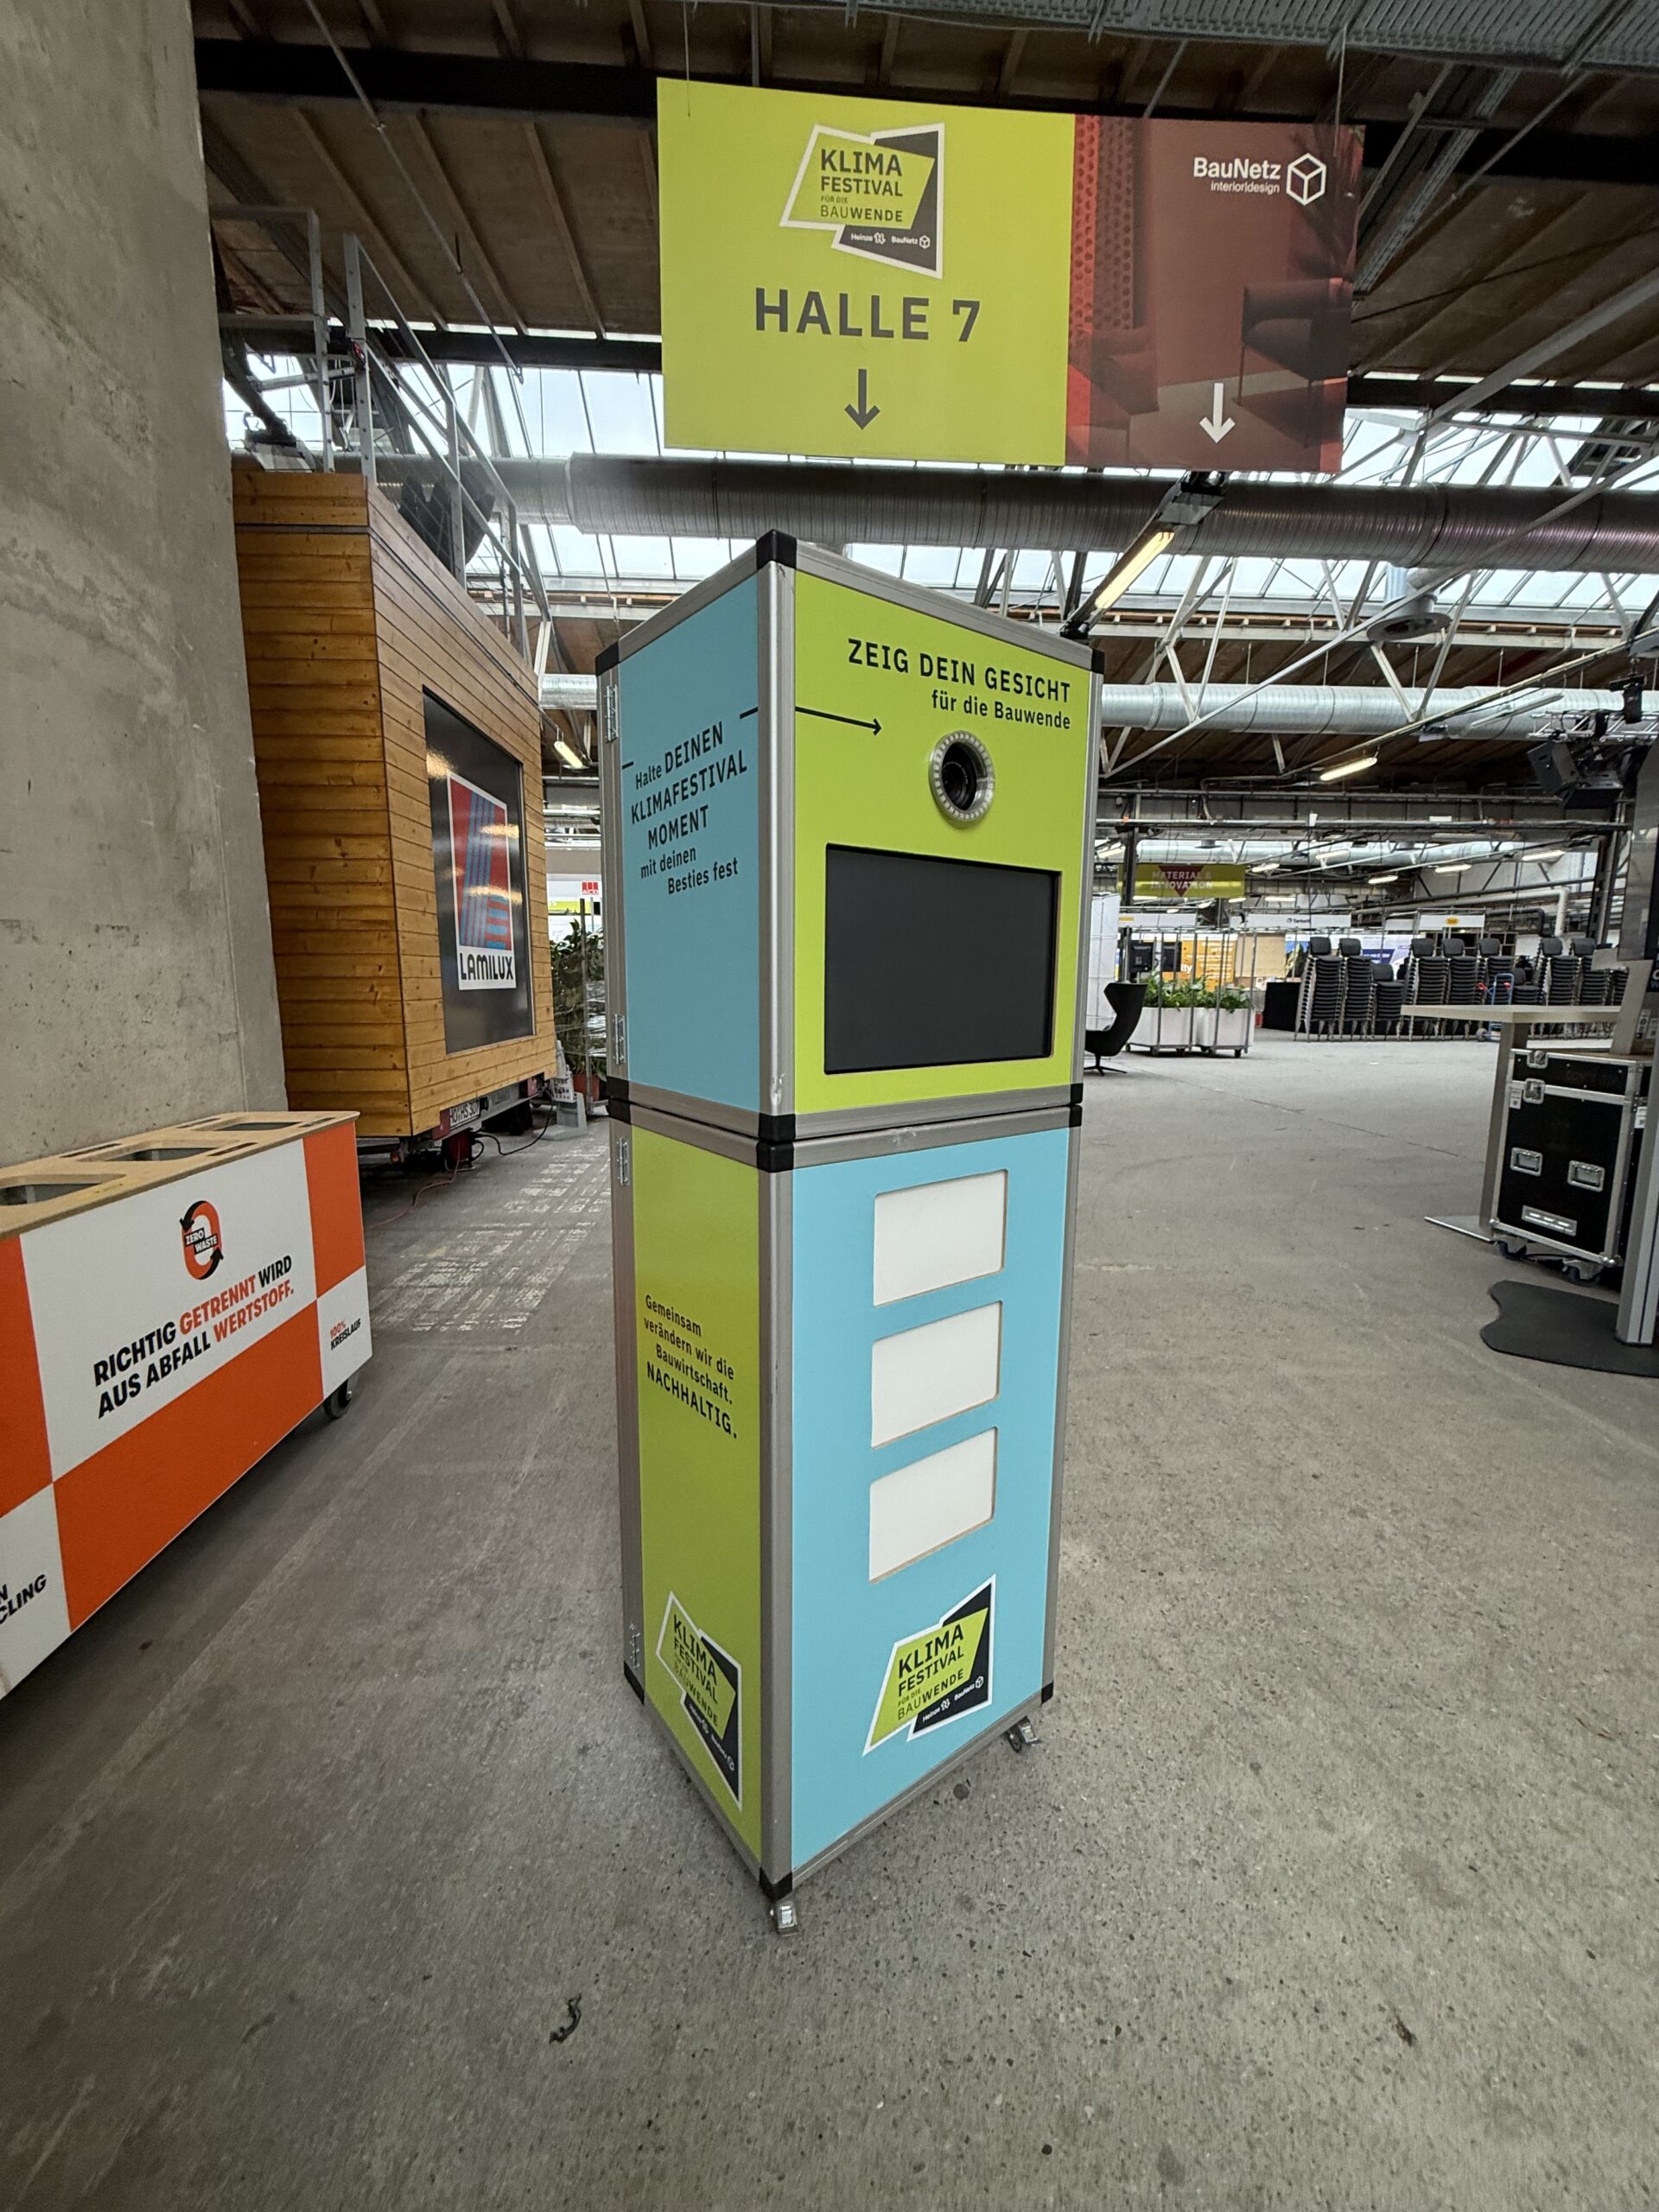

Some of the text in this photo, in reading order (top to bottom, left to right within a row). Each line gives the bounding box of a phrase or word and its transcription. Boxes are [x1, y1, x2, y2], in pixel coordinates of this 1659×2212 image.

[821, 149, 902, 176] KLIMA
[1193, 156, 1281, 180] BauNetz
[821, 176, 903, 197] FESTIVAL
[821, 205, 903, 222] BAUWENDE
[851, 233, 918, 245] Heinze BauNetz
[755, 287, 981, 342] HALLE 7
[848, 638, 1071, 702] ZEIG DEIN GESICHT
[931, 690, 1071, 729] für die Bauwende
[636, 721, 723, 790] Halte DEINEN
[632, 749, 747, 824] KLIMAFESTIVAL
[648, 804, 709, 850] MOMENT
[640, 847, 696, 879] mit deinen
[668, 857, 738, 895] Besties fest
[460, 953, 514, 980] LAMILUX
[185, 1230, 204, 1244] ZERO
[195, 1235, 218, 1253] WASTE
[93, 1255, 292, 1387] RICHTIG GETRENNT WIRD
[330, 1318, 361, 1351] KREISLAUF
[645, 1294, 702, 1337] Gemeinsam
[99, 1279, 295, 1419] AUS ABFALL WERTSTOFF.
[644, 1318, 734, 1380] verändern wir die
[656, 1343, 733, 1404] Bauwirtschaft.
[646, 1361, 737, 1439] NACHHALTIG.
[674, 1614, 718, 1686] KLIMA
[674, 1637, 718, 1704] FESTIVAL
[899, 1624, 964, 1679] KLIMA
[899, 1646, 964, 1697] FESTIVAL
[674, 1662, 719, 1727] BAUWENDE
[898, 1669, 963, 1720] BAUWENDE
[898, 1689, 921, 1707] FÜR DIE
[922, 1684, 975, 1722] Heinze BauNetz
